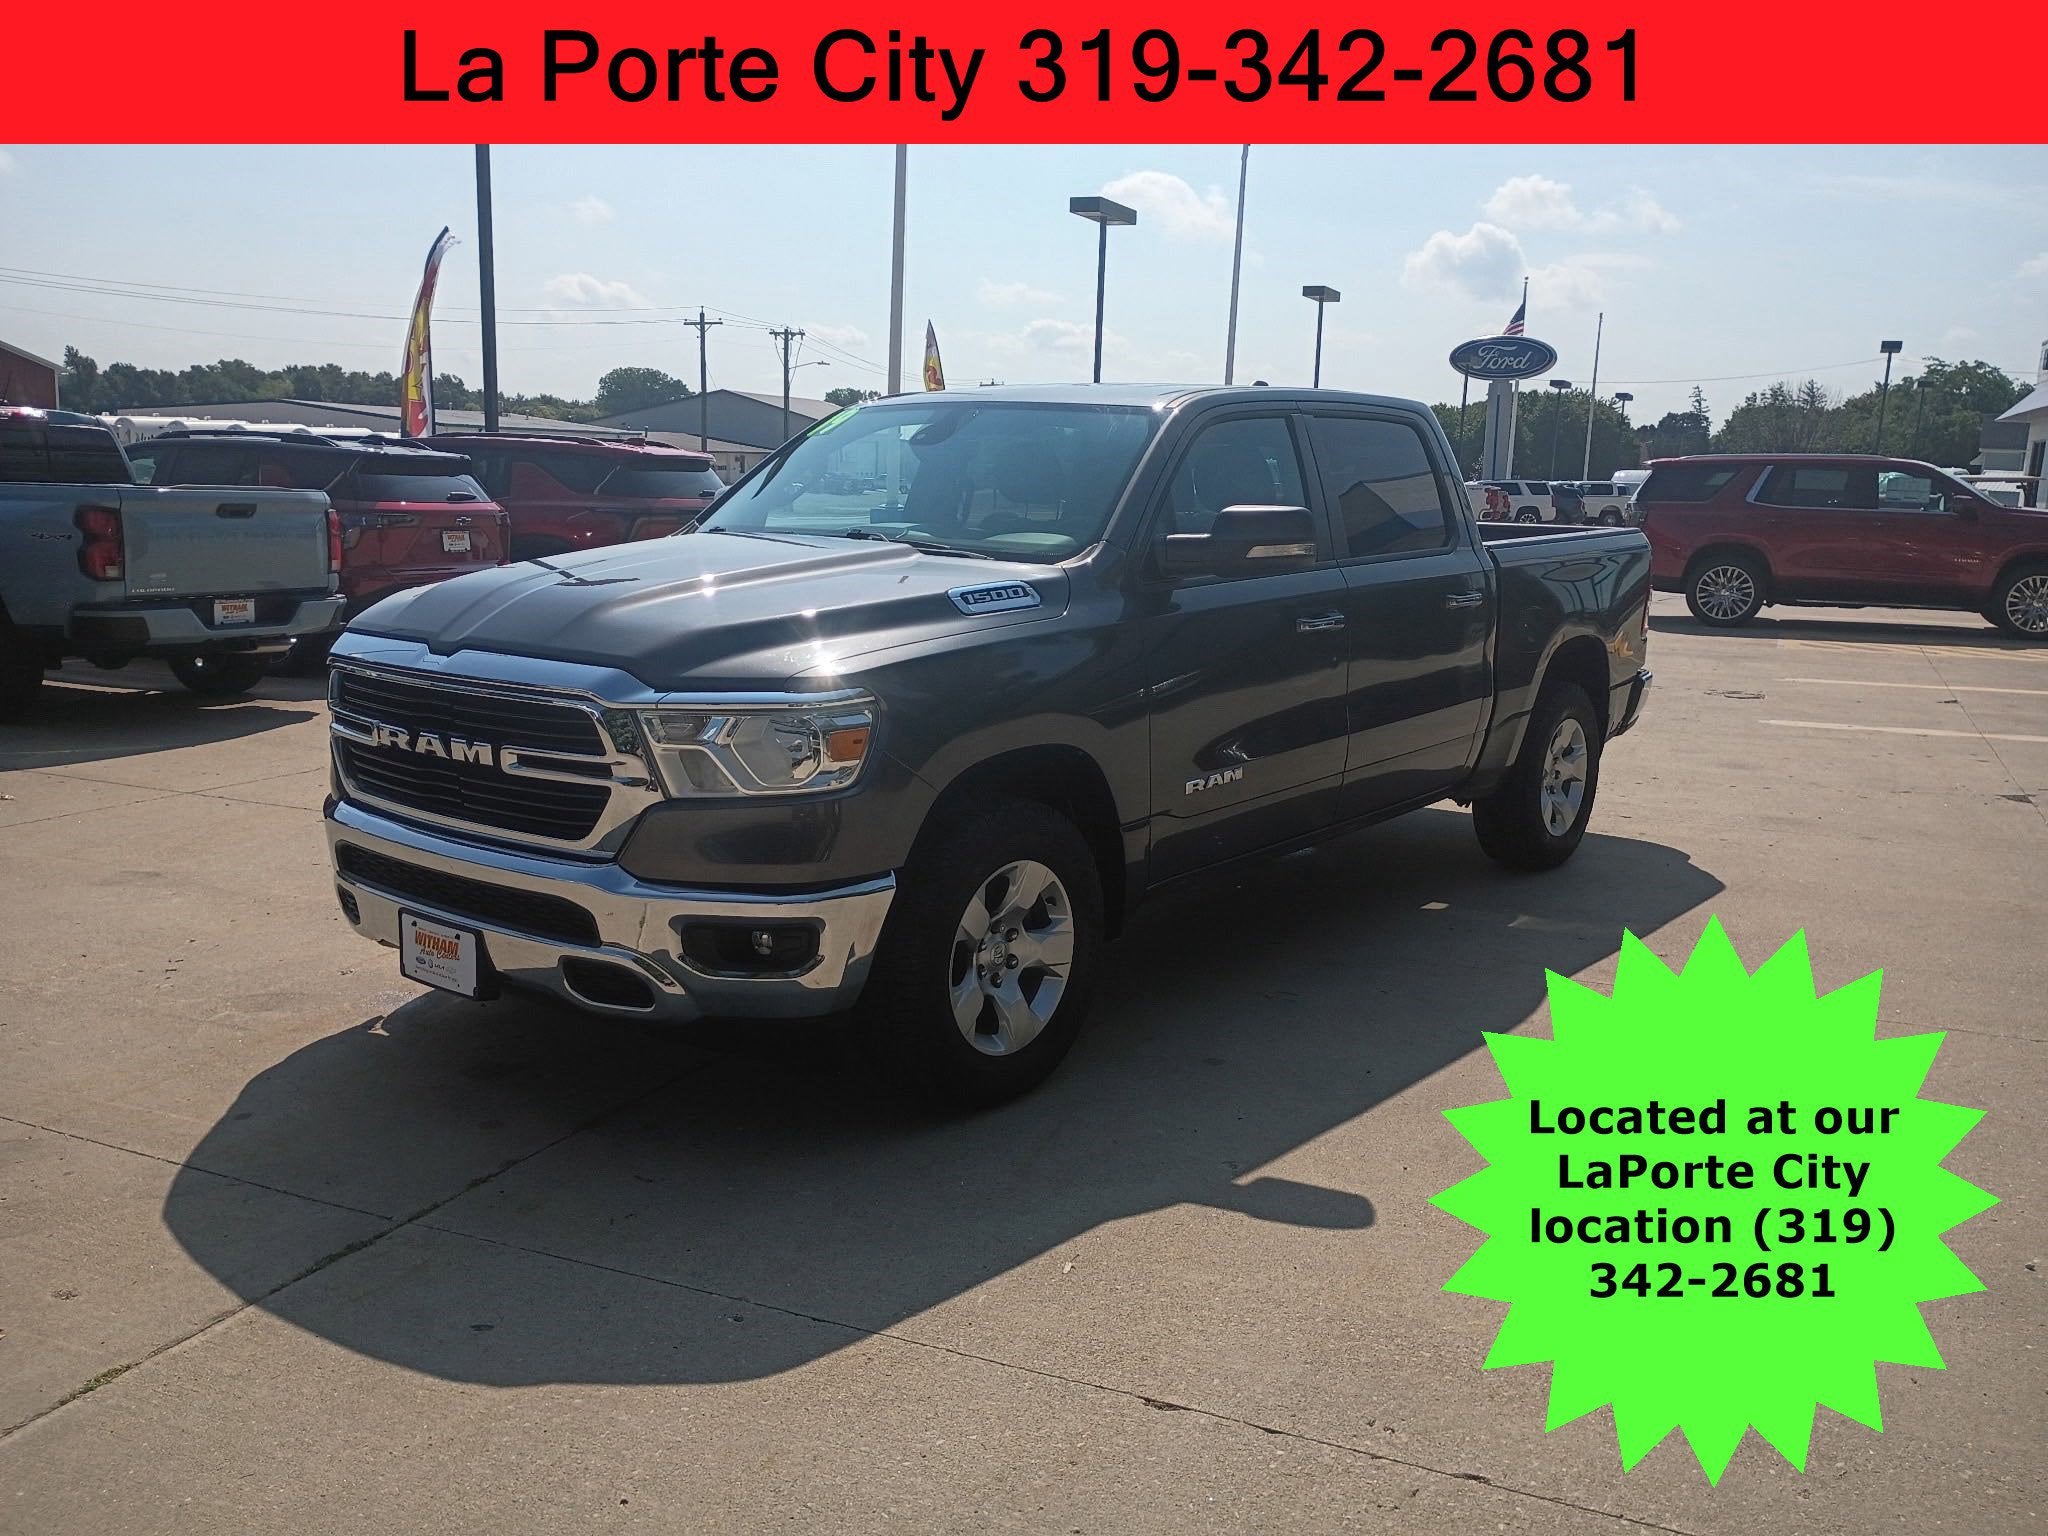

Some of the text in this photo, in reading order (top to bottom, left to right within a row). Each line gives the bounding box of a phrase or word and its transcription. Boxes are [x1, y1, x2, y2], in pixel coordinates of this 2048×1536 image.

[1473, 345, 1533, 370] Ford
[963, 587, 1025, 604] 1500
[379, 722, 494, 767] RAM
[1185, 766, 1243, 795] RAM
[415, 930, 460, 956] WITHAM
